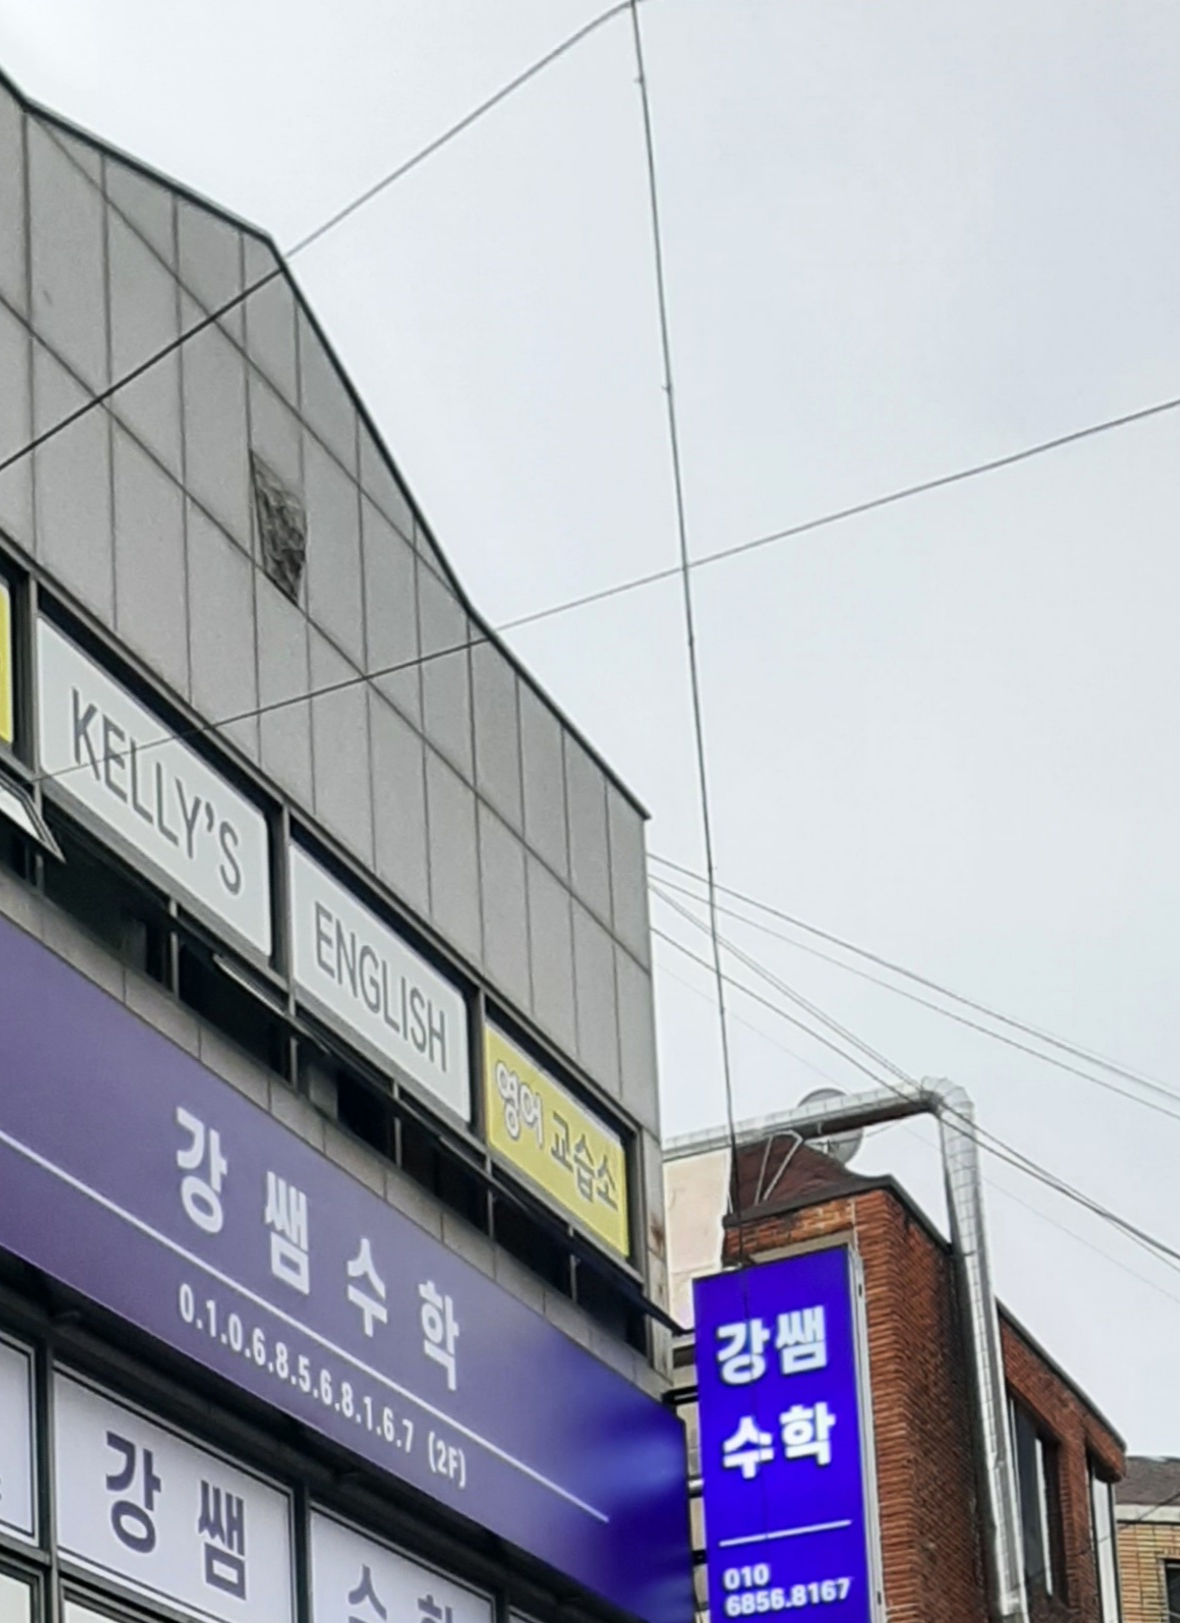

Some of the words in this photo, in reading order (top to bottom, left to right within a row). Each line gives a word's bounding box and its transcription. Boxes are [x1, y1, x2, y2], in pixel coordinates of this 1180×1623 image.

[71, 686, 244, 898] KELLY'S
[313, 900, 448, 1073] ENGLISH
[495, 1059, 545, 1151] 영어
[551, 1108, 619, 1212] 교습소
[717, 1306, 828, 1386] 강쌤
[427, 1434, 468, 1489] (2F)
[722, 1402, 836, 1480] 수학
[723, 1563, 770, 1592] 010
[725, 1577, 852, 1618] 6856.8167
